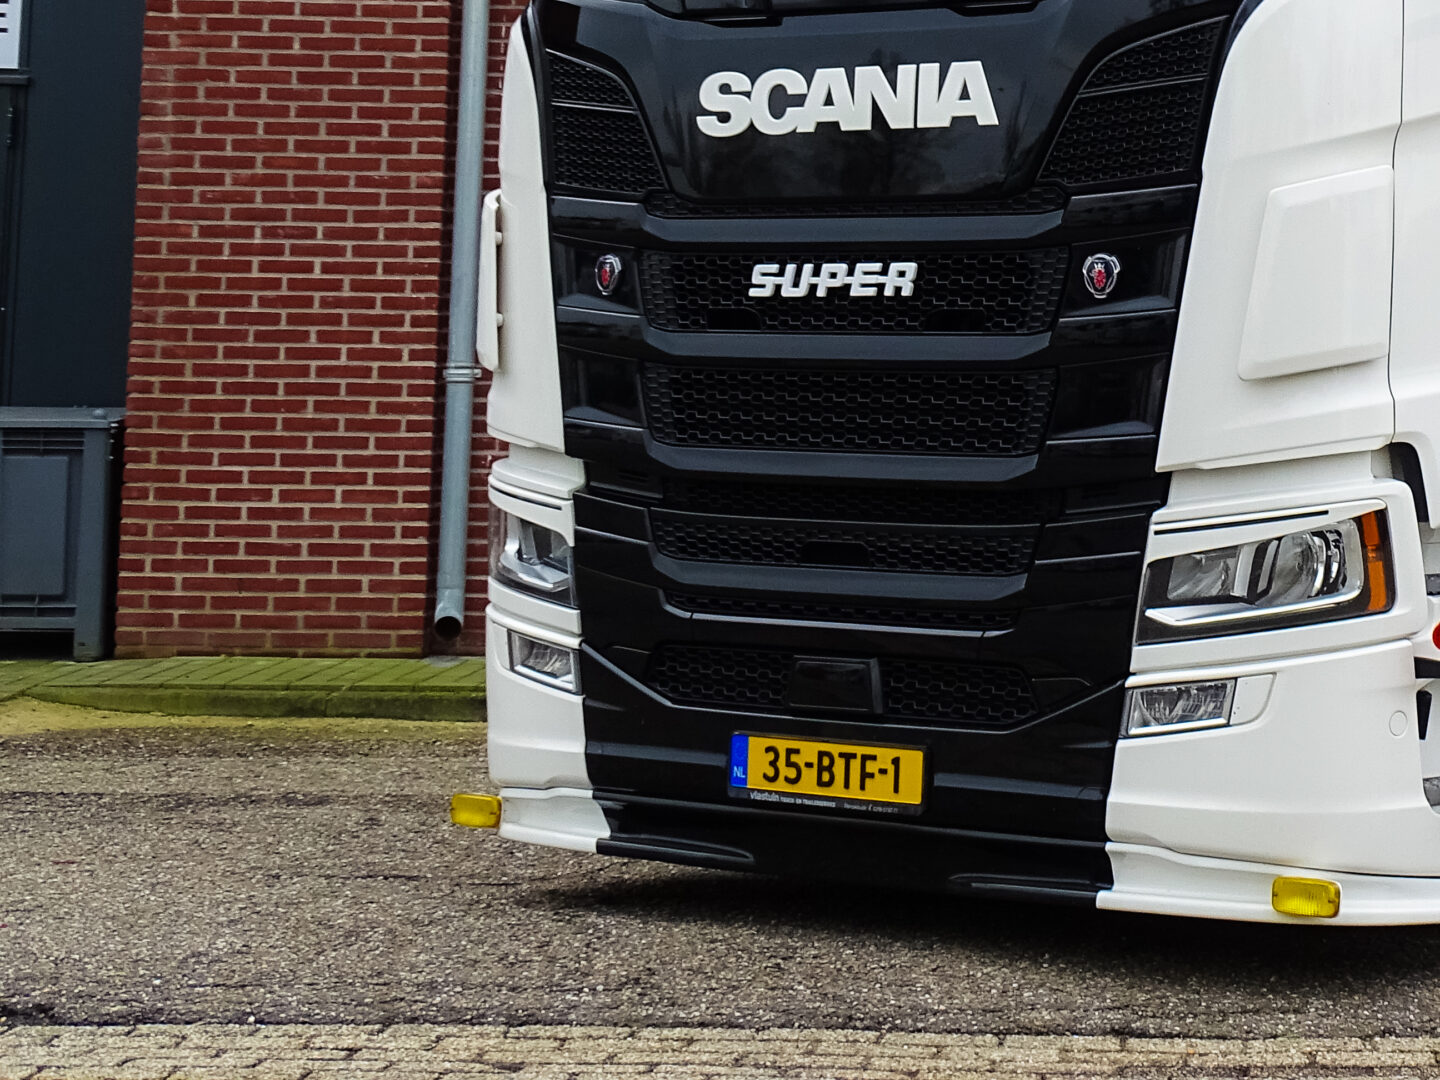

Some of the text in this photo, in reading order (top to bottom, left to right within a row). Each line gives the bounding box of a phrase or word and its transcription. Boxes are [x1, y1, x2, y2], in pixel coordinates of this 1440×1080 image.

[696, 60, 999, 138] SCANIA
[748, 261, 918, 299] SUPER
[733, 745, 901, 794] NL 35-BTF-1
